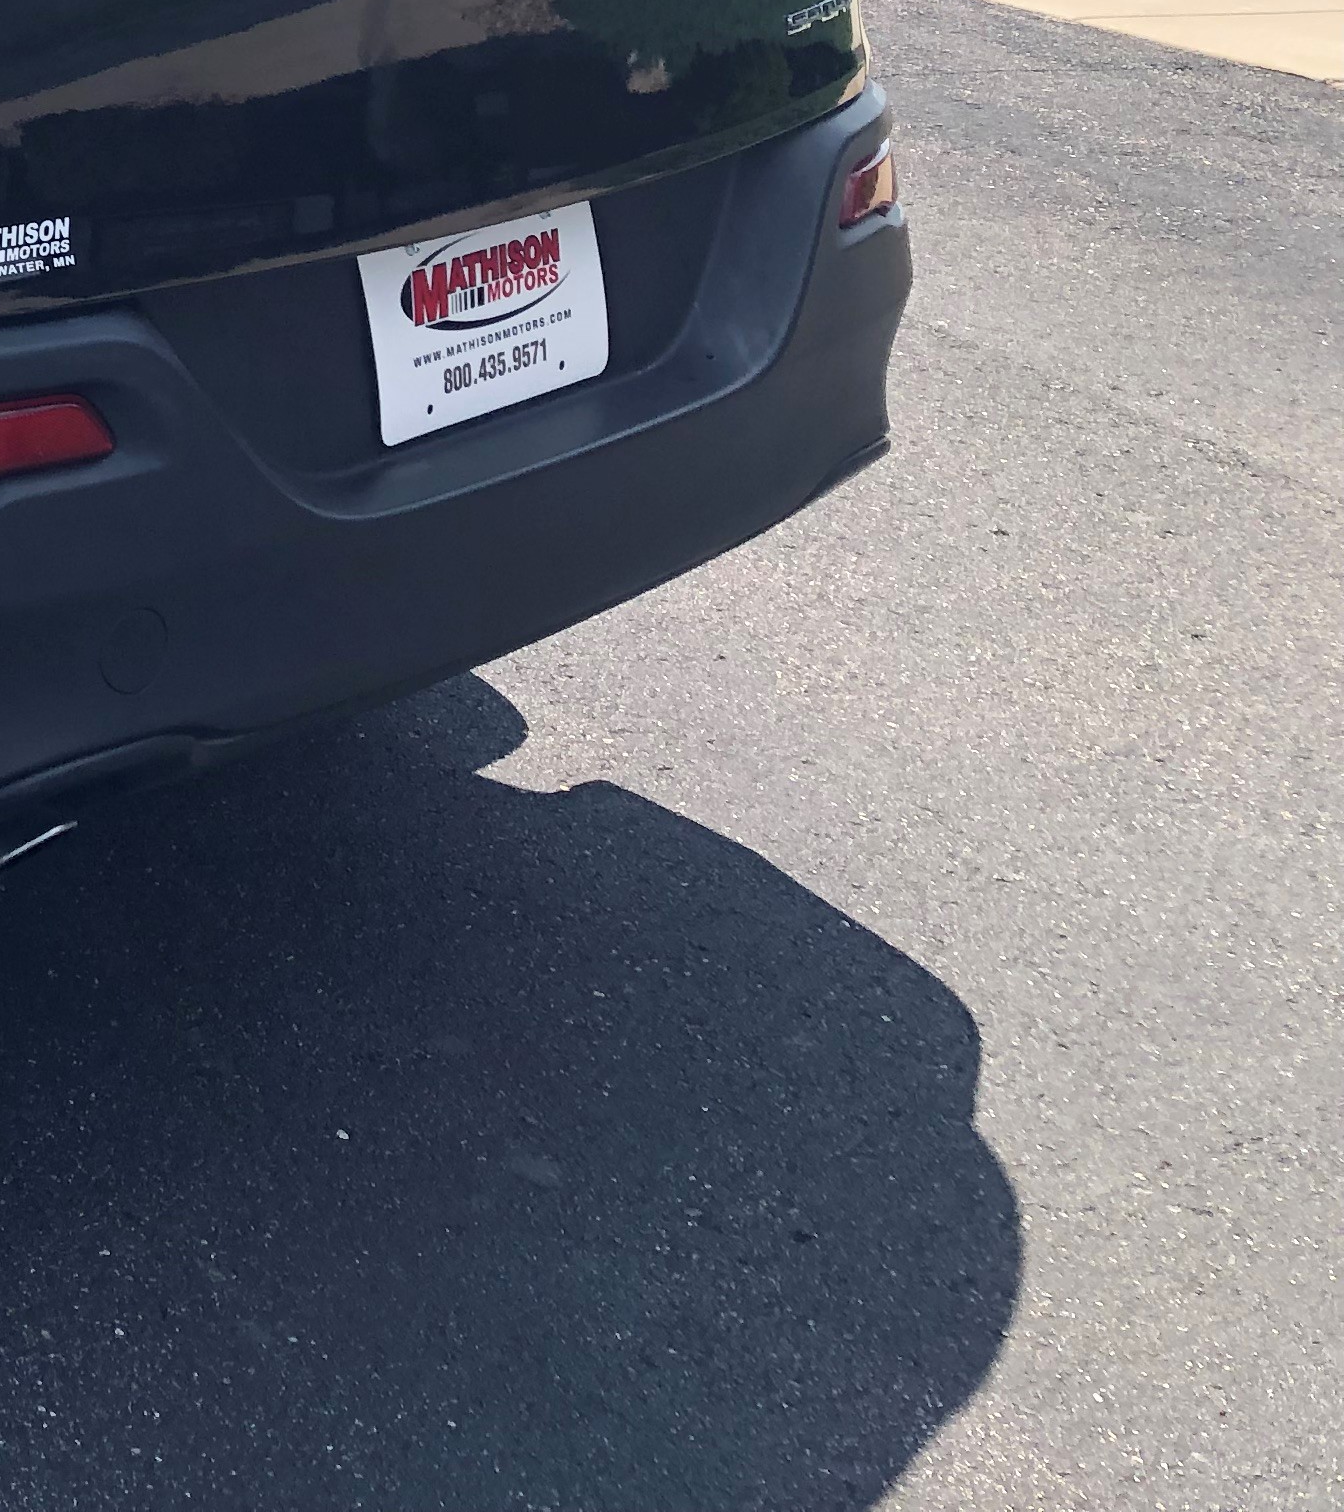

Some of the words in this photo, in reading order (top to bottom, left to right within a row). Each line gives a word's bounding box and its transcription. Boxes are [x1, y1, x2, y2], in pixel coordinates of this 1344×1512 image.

[7, 240, 70, 262] MOTORS
[53, 255, 76, 268] MN
[411, 228, 560, 327] MATHISON
[487, 265, 559, 303] MOTORS
[412, 308, 572, 369] WWW.MATHISONMOTORS.COM
[443, 338, 548, 395] 800.435.9571
